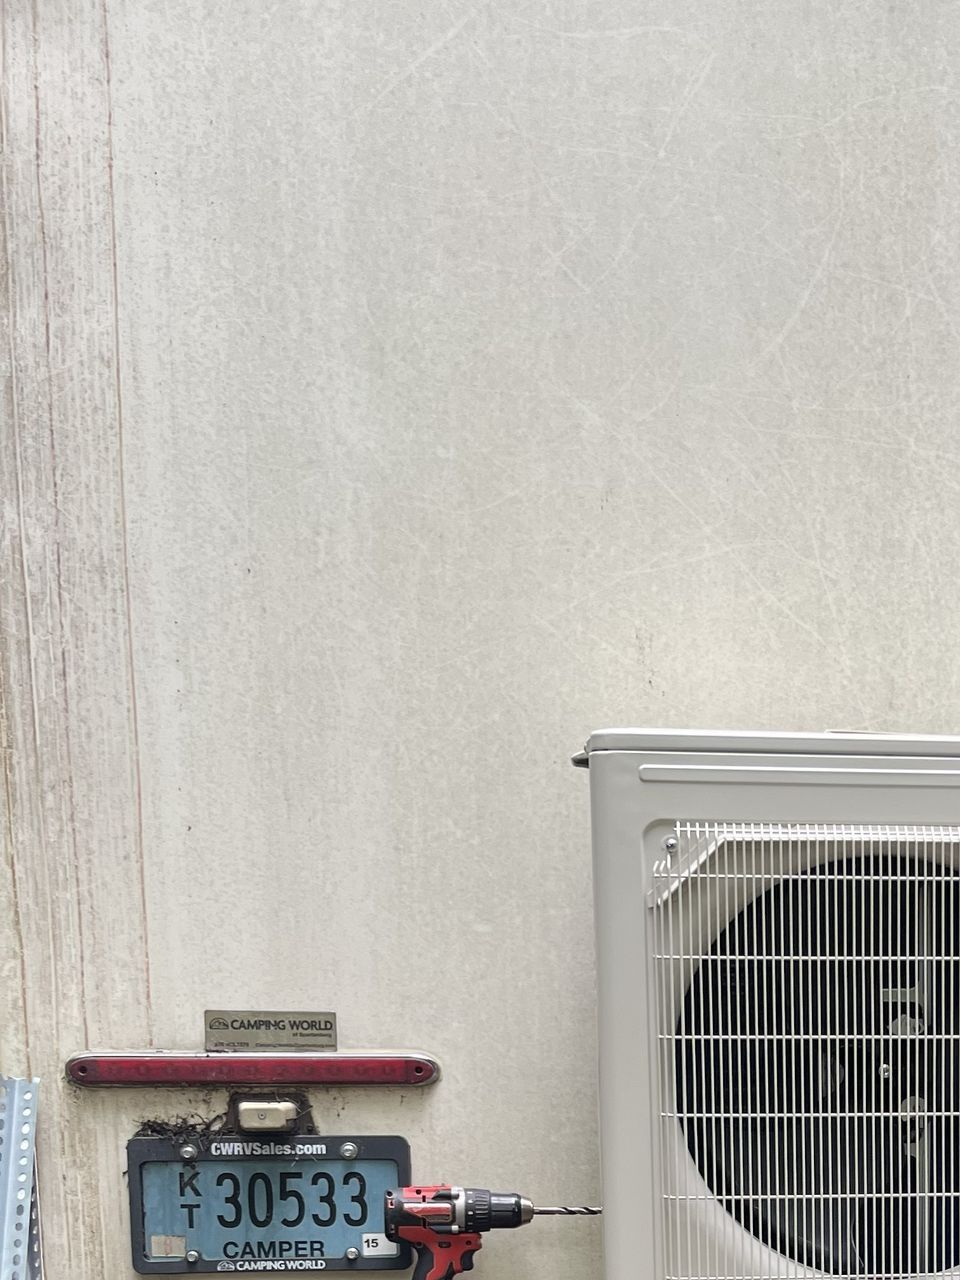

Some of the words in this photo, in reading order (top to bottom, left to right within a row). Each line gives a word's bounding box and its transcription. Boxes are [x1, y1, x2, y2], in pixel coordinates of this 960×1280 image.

[230, 1019, 286, 1031] CAMPING
[288, 1020, 333, 1031] WORLD
[210, 1142, 327, 1155] CWRVSales.com
[215, 1171, 369, 1229] 30533
[363, 1238, 379, 1248] 15
[222, 1240, 325, 1259] CAMPER
[236, 1259, 286, 1271] CAMPING
[286, 1260, 326, 1271] WORLD
